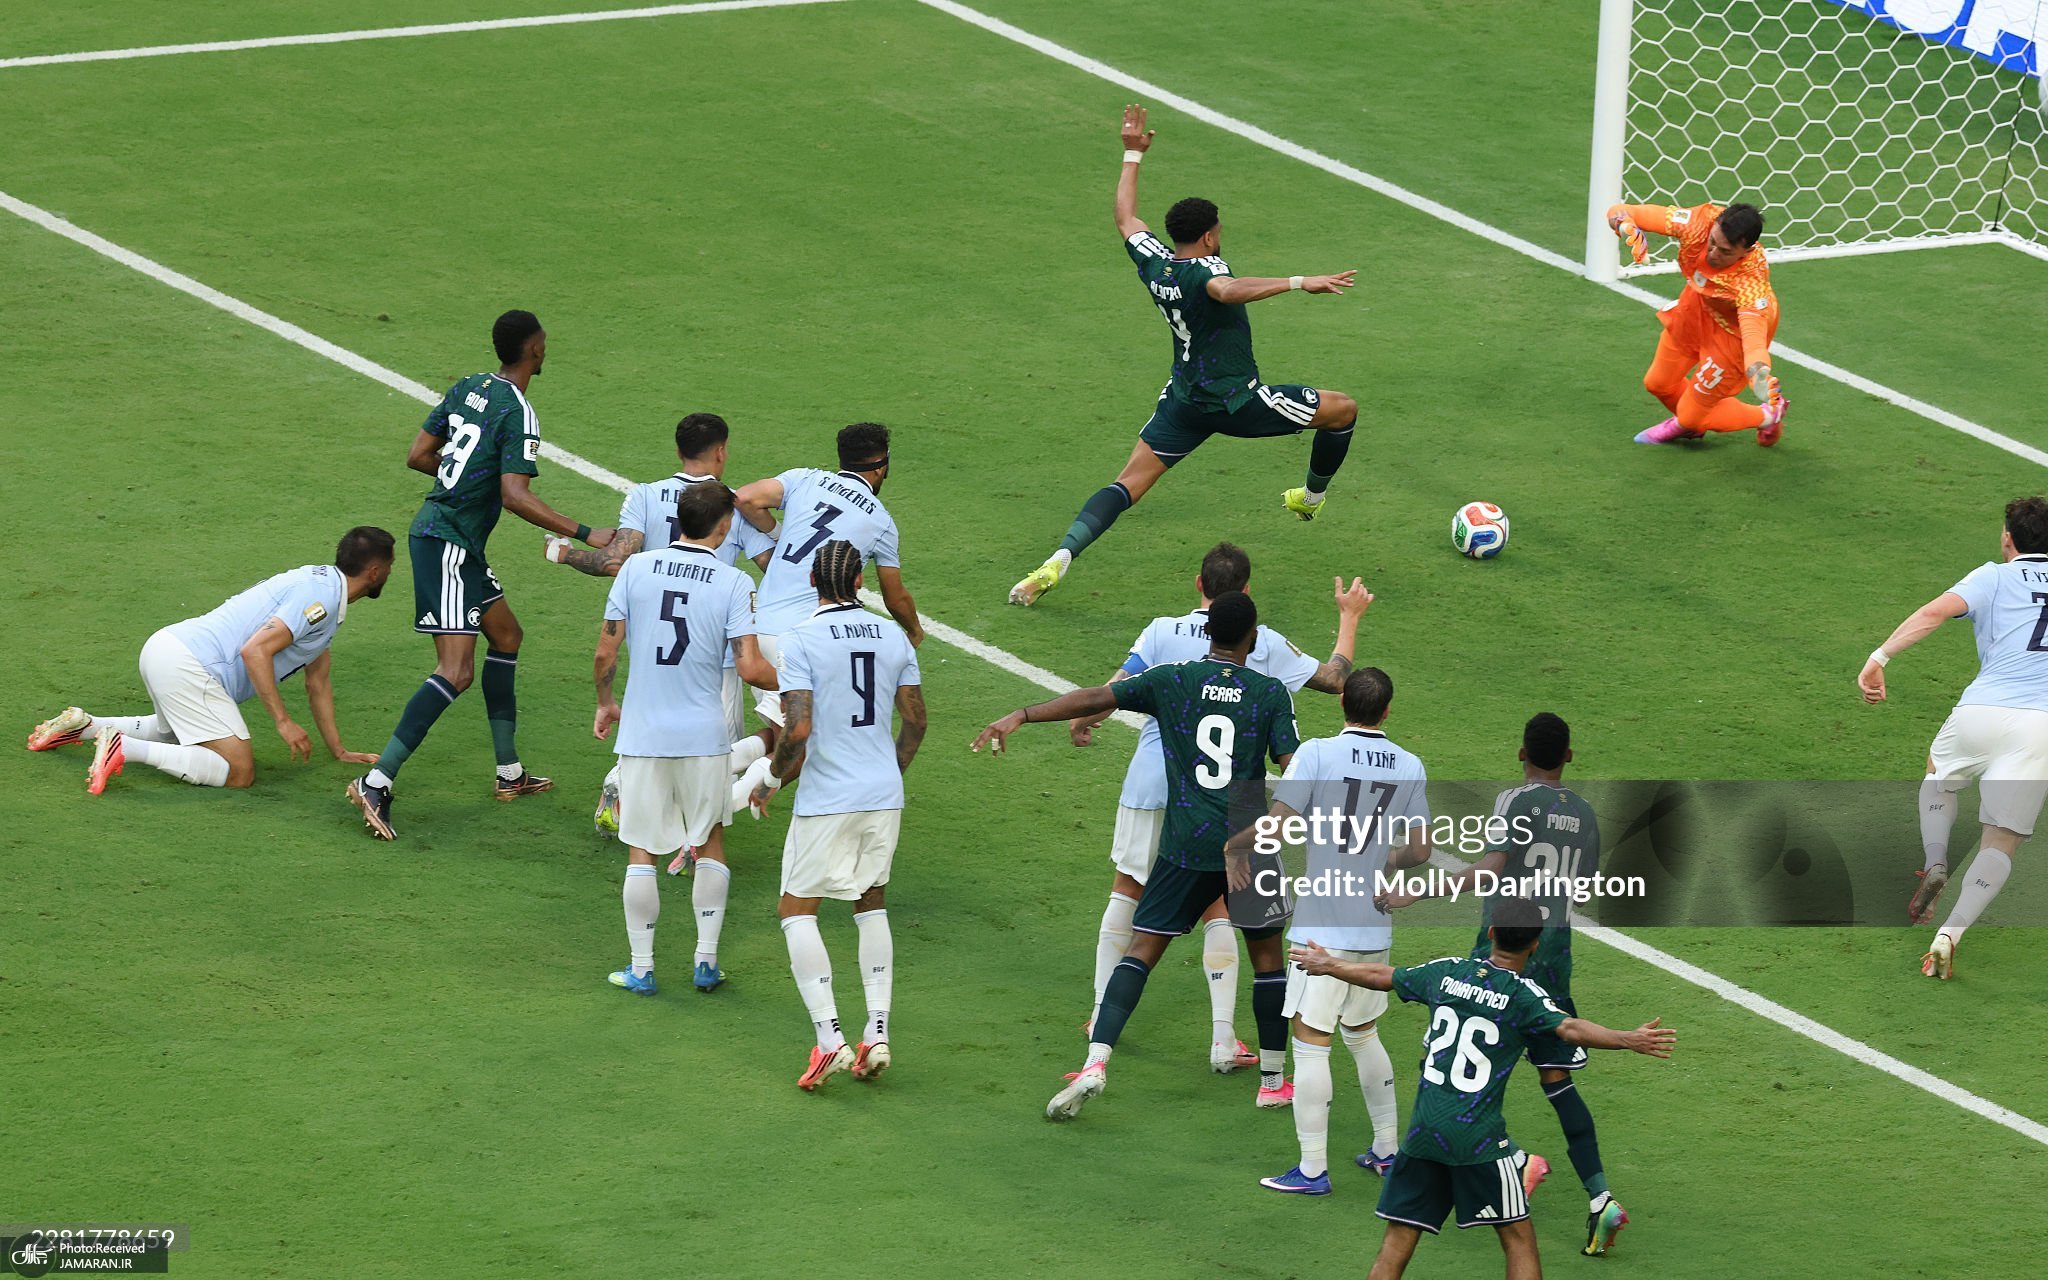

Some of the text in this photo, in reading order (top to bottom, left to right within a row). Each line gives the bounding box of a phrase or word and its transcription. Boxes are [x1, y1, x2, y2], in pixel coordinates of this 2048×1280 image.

[1695, 356, 1725, 389] 23
[437, 413, 481, 490] 29
[782, 501, 843, 565] 3
[656, 590, 690, 666] 5
[851, 651, 875, 728] 9
[1201, 685, 1243, 703] FERAS
[1195, 714, 1235, 790] 9
[1338, 776, 1398, 855] 17
[1439, 976, 1510, 1010] MOHAMMED
[1423, 1005, 1500, 1093] 26
